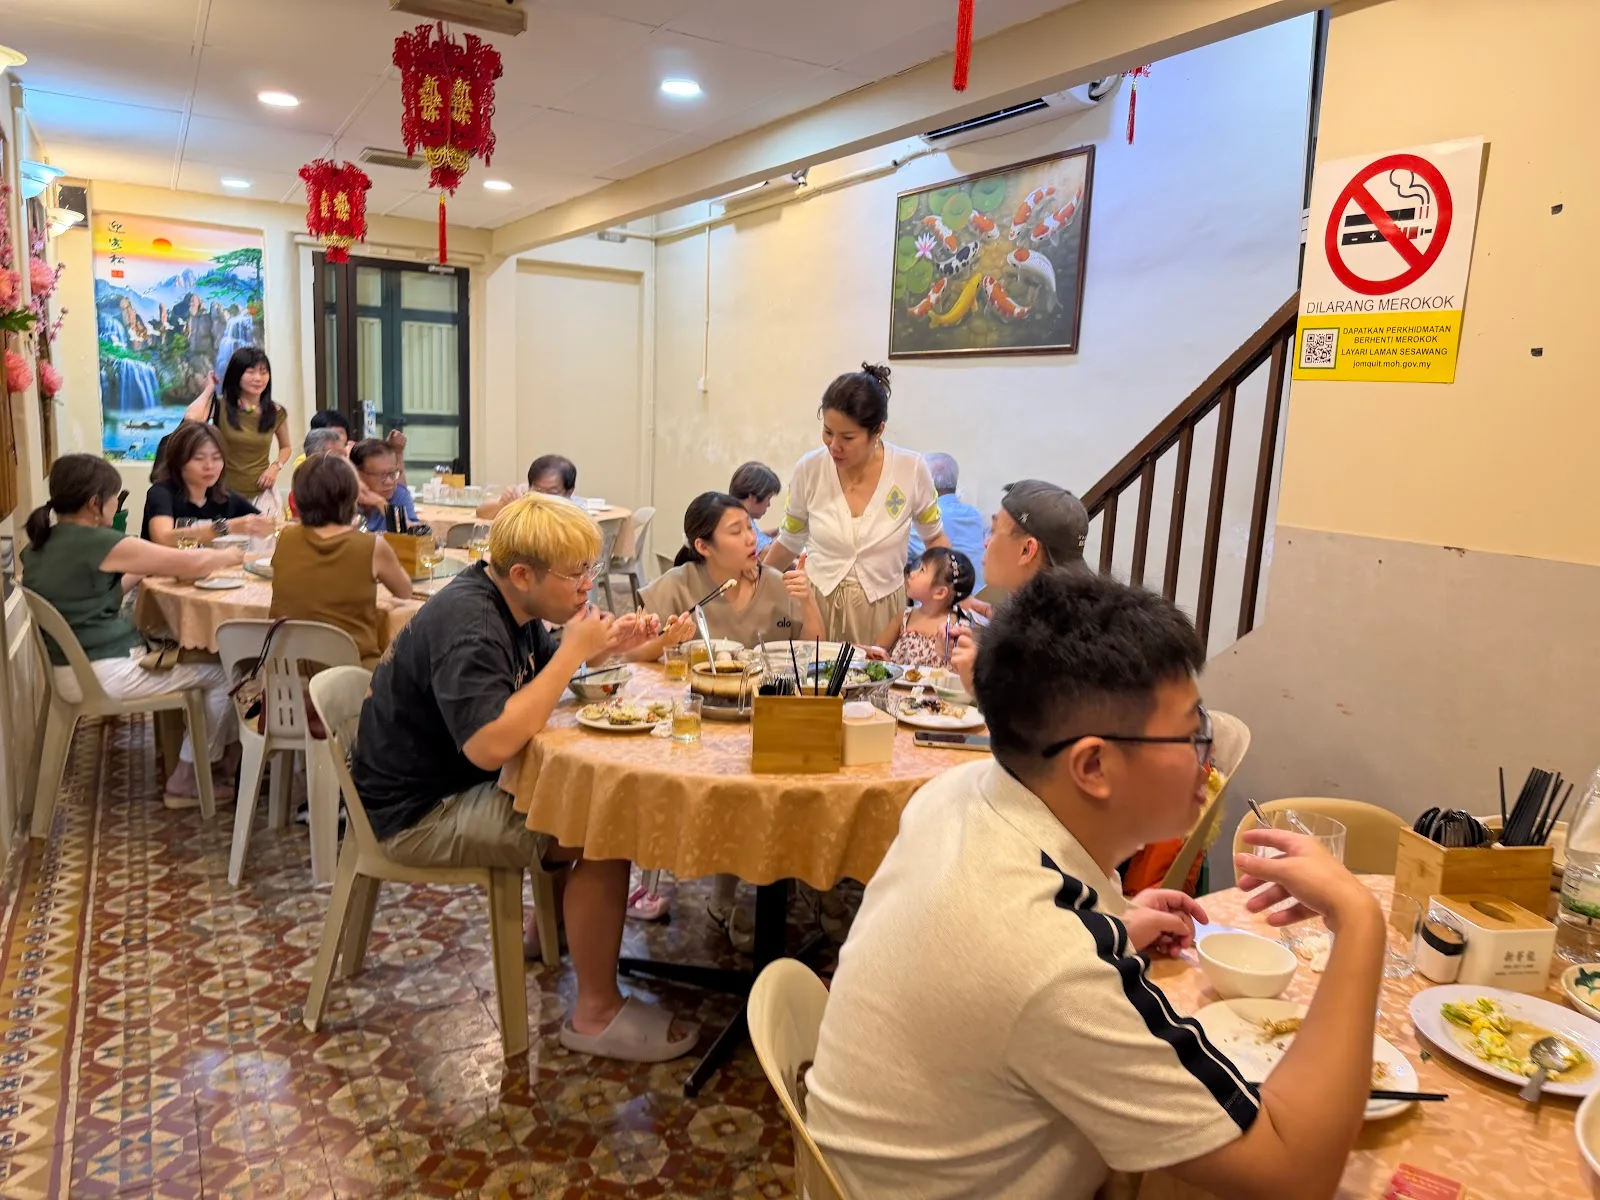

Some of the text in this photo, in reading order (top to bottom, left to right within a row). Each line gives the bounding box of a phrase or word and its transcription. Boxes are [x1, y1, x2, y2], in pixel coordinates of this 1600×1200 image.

[1307, 296, 1454, 313] DILARANG MEROKOK
[1343, 325, 1451, 334] DAPATKAN PERKHIDMATAN
[1354, 335, 1438, 344] BERHENTI MEROKOK
[1341, 347, 1448, 356] LAYARI LAMAN SESAWANG
[1352, 360, 1431, 369] jomquit.moh.gov.my
[777, 617, 791, 627] alo
